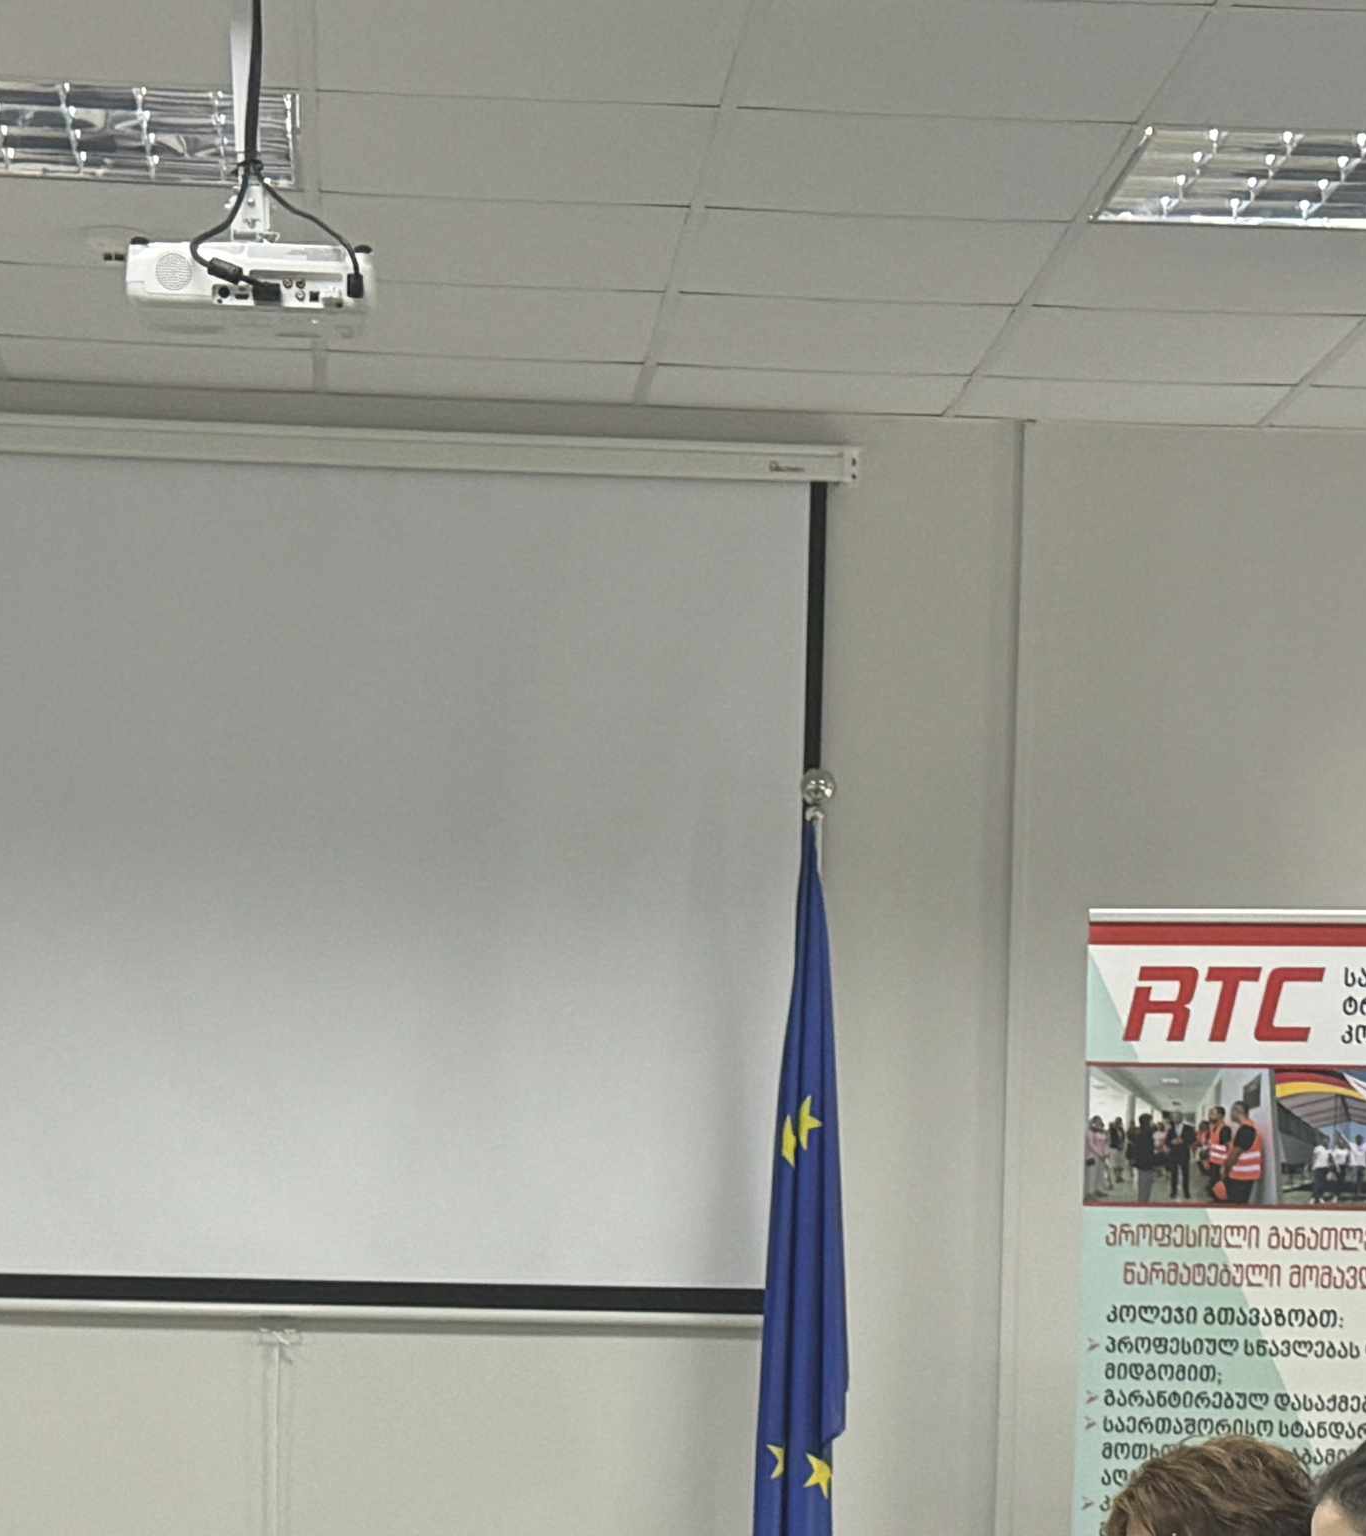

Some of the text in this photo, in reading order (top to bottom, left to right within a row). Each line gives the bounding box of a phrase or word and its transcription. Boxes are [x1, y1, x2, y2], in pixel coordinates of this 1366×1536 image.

[1122, 965, 1326, 1043] RTC
[1104, 1223, 1261, 1251] პროფესიული
[1106, 1304, 1198, 1325] კოლეჯი
[1104, 1335, 1240, 1357] პროფესიულ
[1103, 1388, 1270, 1412] გარანტირებულ
[1102, 1415, 1275, 1437] საერთაშორისო
